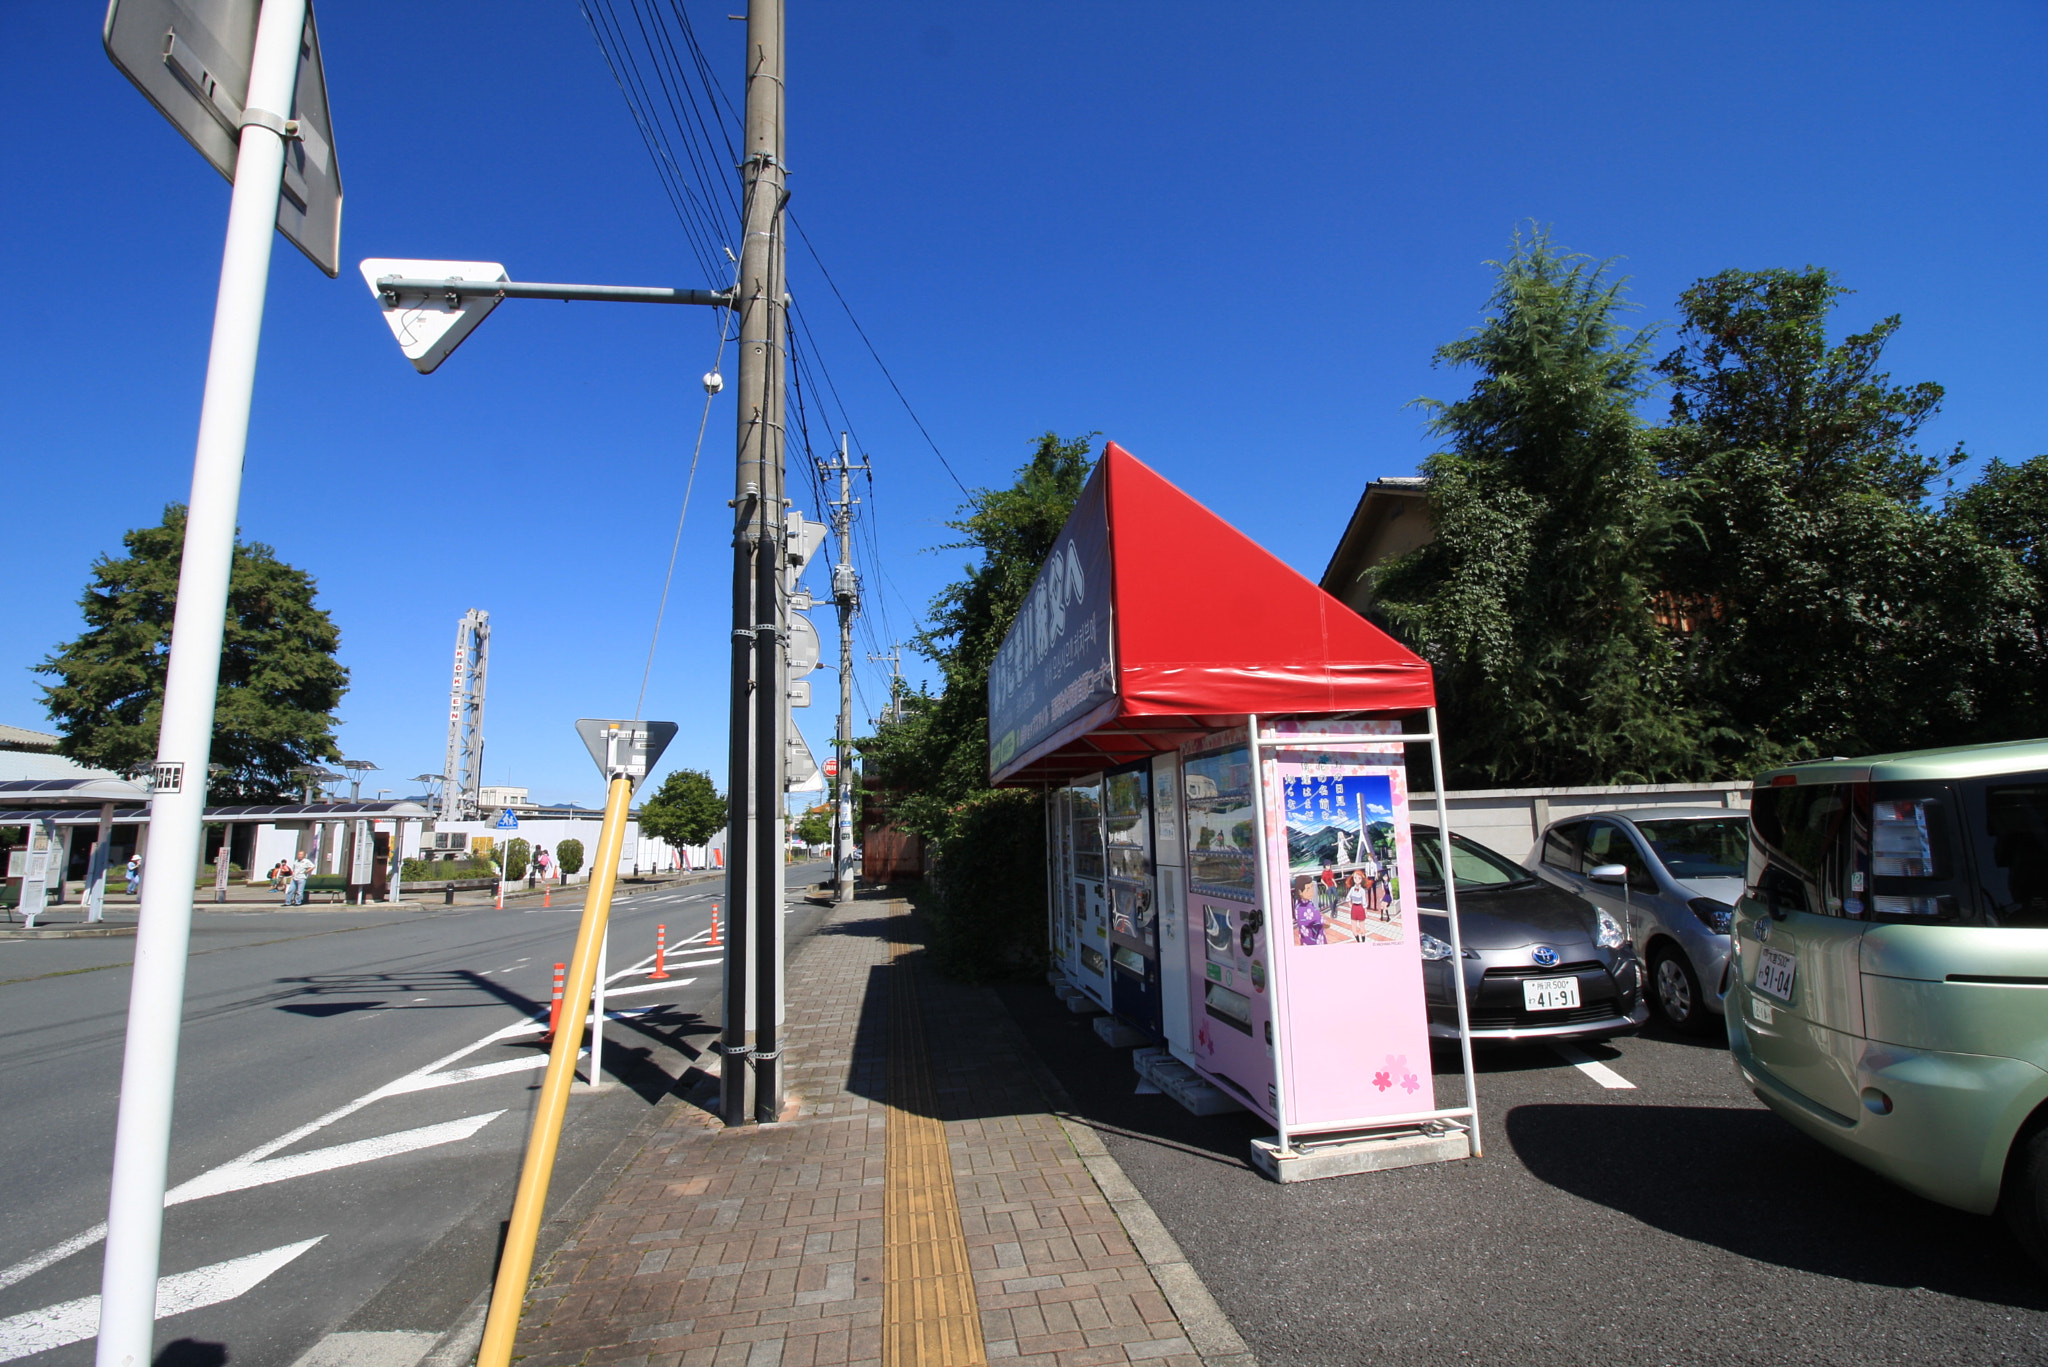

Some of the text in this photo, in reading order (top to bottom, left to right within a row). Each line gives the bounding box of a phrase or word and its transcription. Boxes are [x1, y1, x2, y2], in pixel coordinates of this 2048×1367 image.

[451, 651, 463, 719] KOKEN
[1552, 980, 1567, 990] 500
[1763, 965, 1790, 995] 91-04
[1537, 990, 1575, 1007] 41-91
